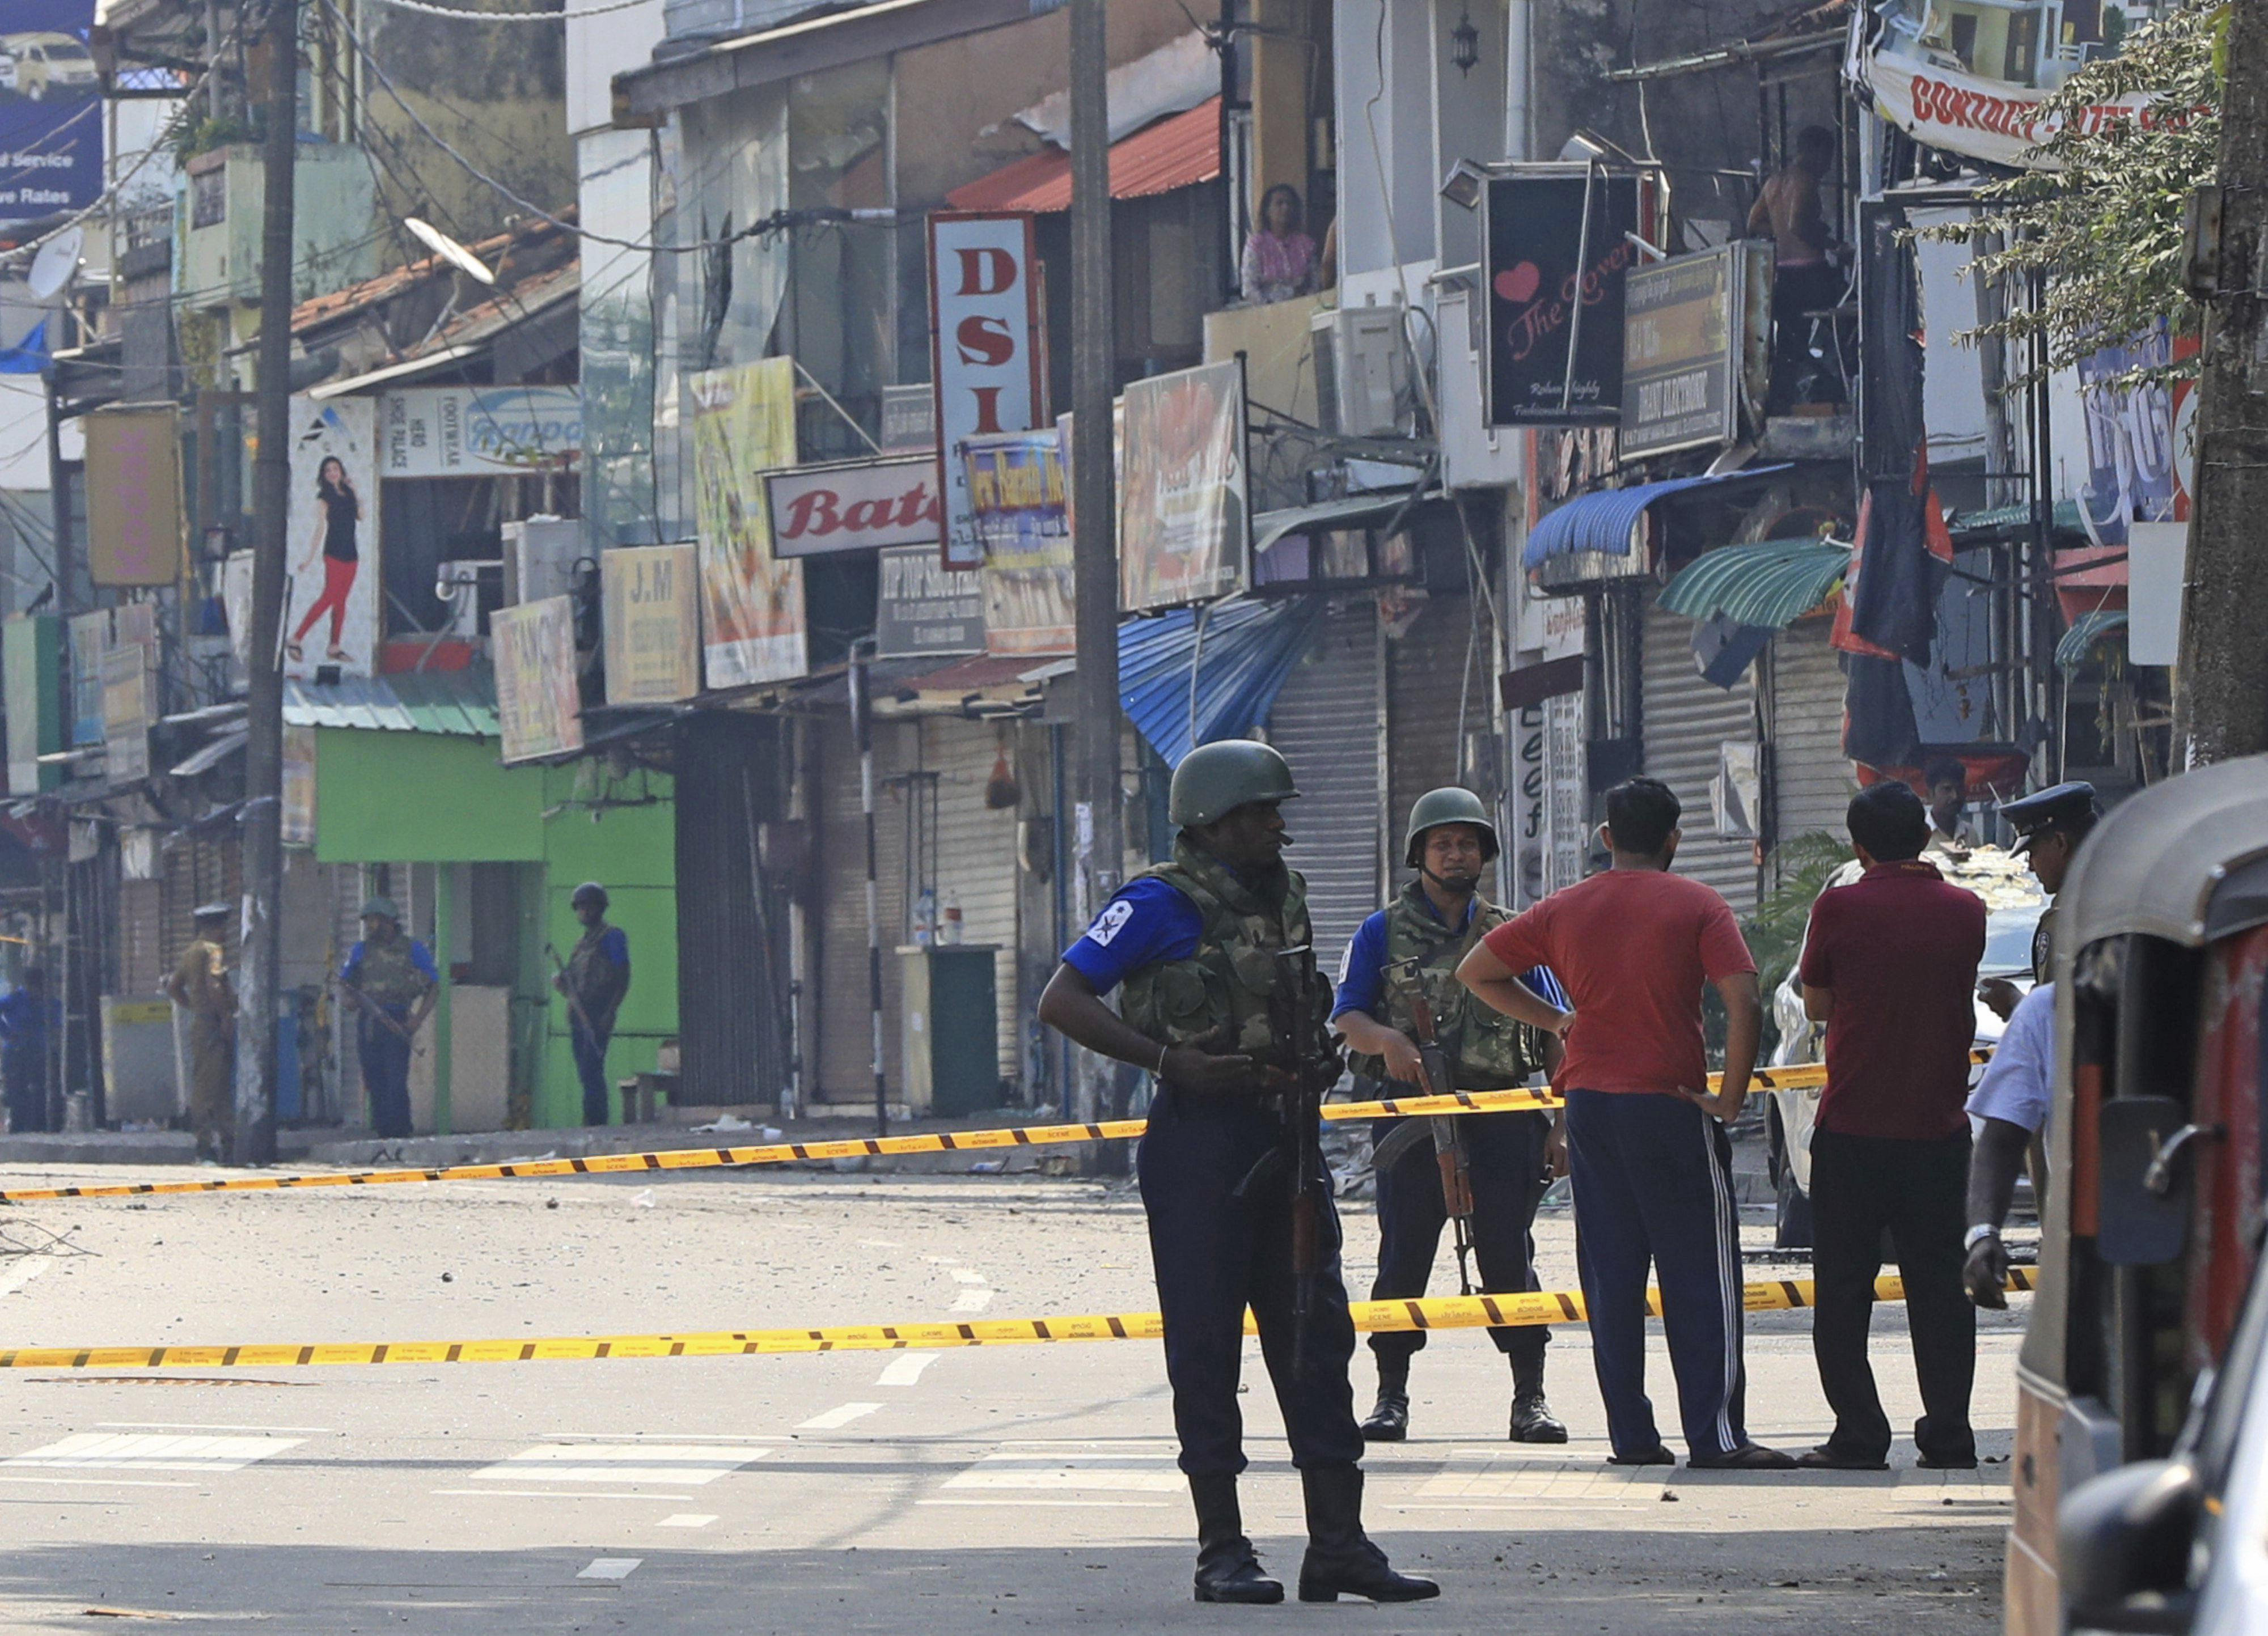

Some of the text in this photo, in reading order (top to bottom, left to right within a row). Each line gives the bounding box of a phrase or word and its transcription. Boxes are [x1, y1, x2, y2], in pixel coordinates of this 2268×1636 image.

[11, 152, 74, 168] Service
[20, 188, 70, 205] Rates
[952, 247, 1018, 436] DSI
[1507, 298, 1564, 361] The
[110, 427, 150, 577] Kodak
